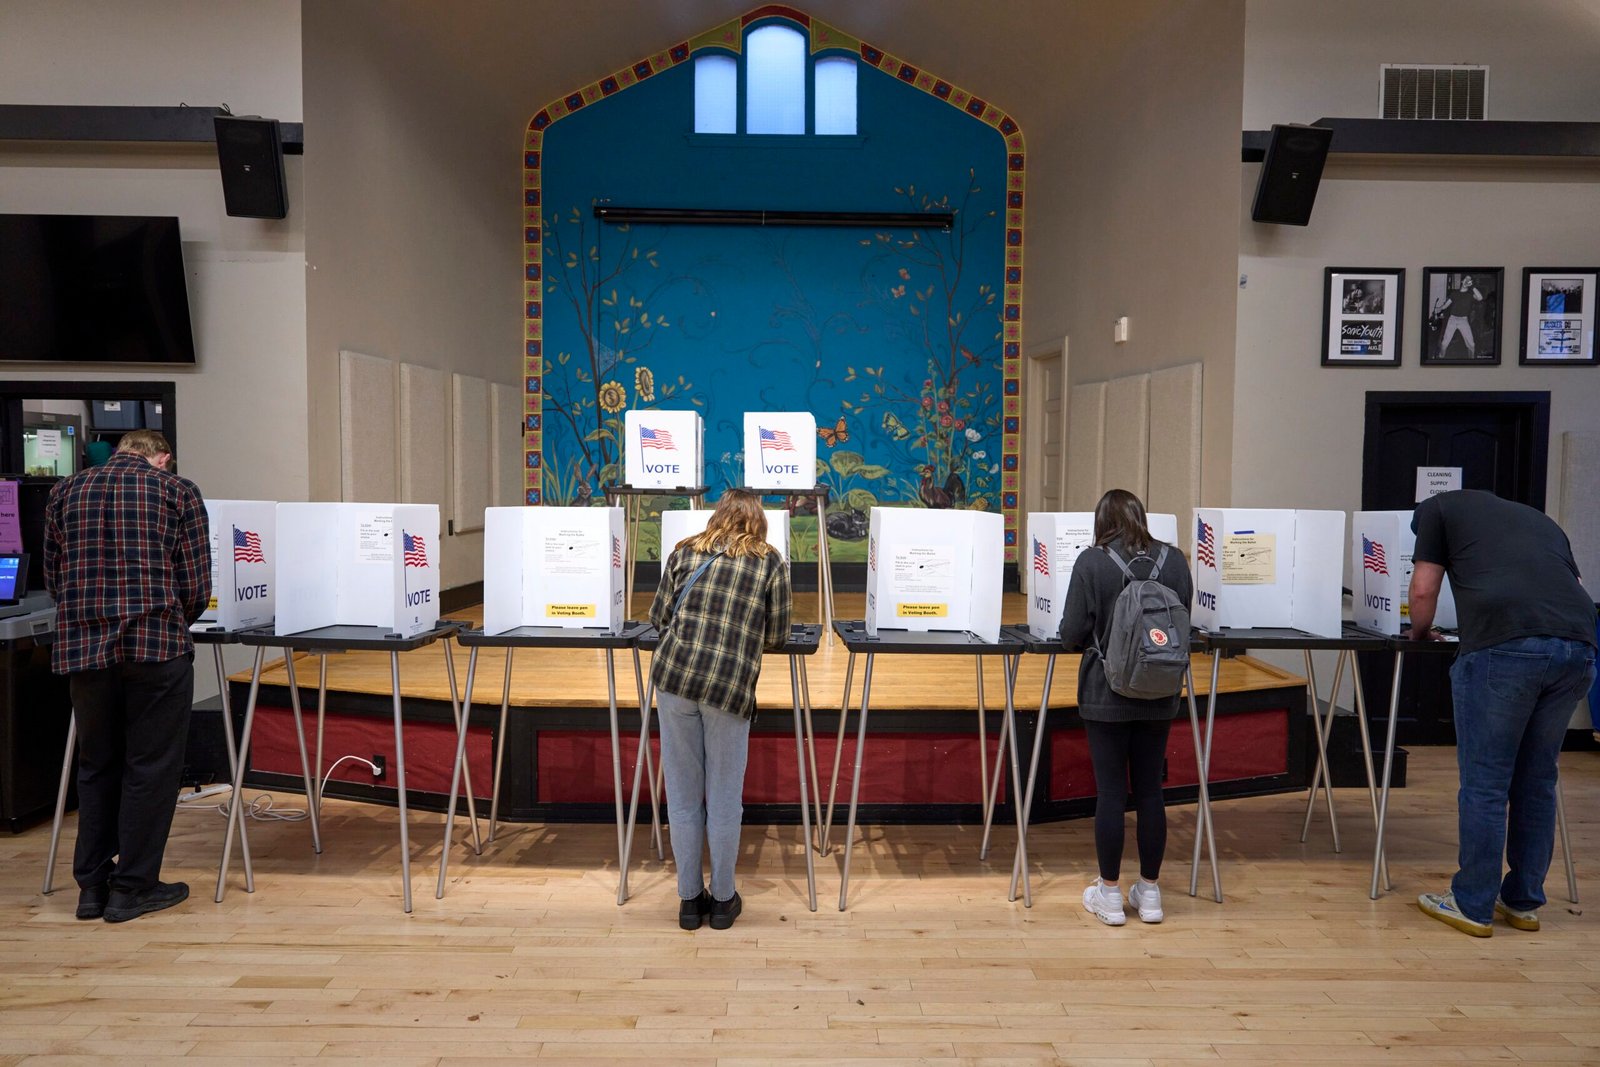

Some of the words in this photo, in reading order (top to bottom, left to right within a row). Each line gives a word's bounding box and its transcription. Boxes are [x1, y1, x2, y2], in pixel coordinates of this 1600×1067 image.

[646, 464, 680, 474] VOTE
[765, 464, 799, 474] VOTE
[238, 584, 267, 601] VOTE
[408, 588, 430, 607] VOTE
[1198, 590, 1216, 611] VOTE
[1036, 595, 1051, 614] VOTE
[1366, 594, 1390, 612] VOTE
